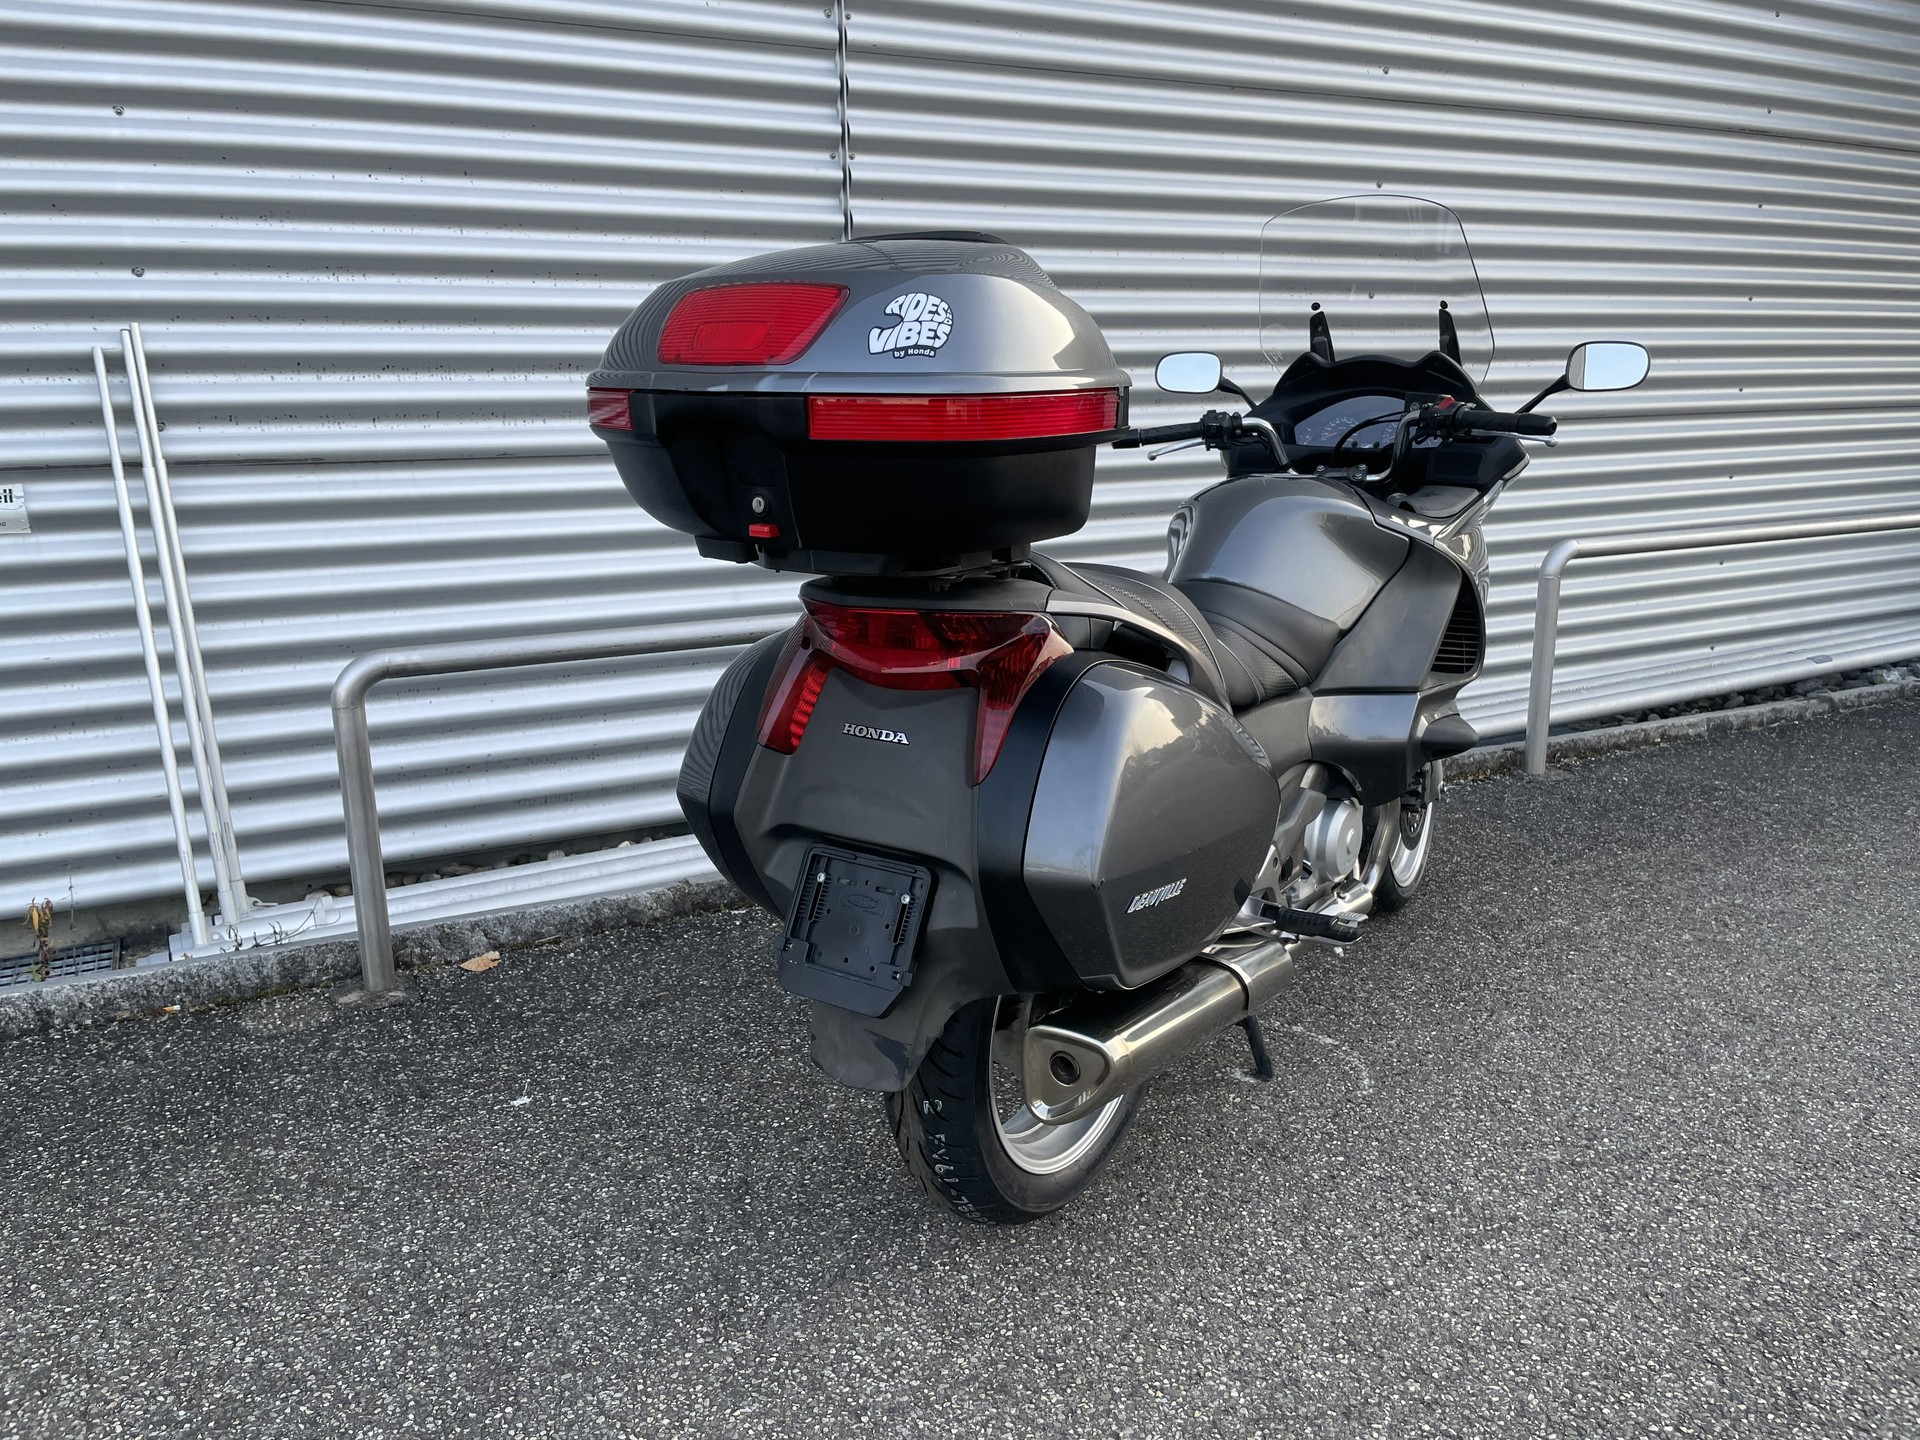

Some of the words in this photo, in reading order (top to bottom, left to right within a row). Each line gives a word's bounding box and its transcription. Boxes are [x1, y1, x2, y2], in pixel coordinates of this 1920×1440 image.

[885, 293, 949, 322] RIDES
[869, 321, 952, 354] VIBES
[908, 348, 935, 356] Honda
[842, 723, 909, 745] HONDA
[1124, 878, 1187, 914] DEAUVILLE
